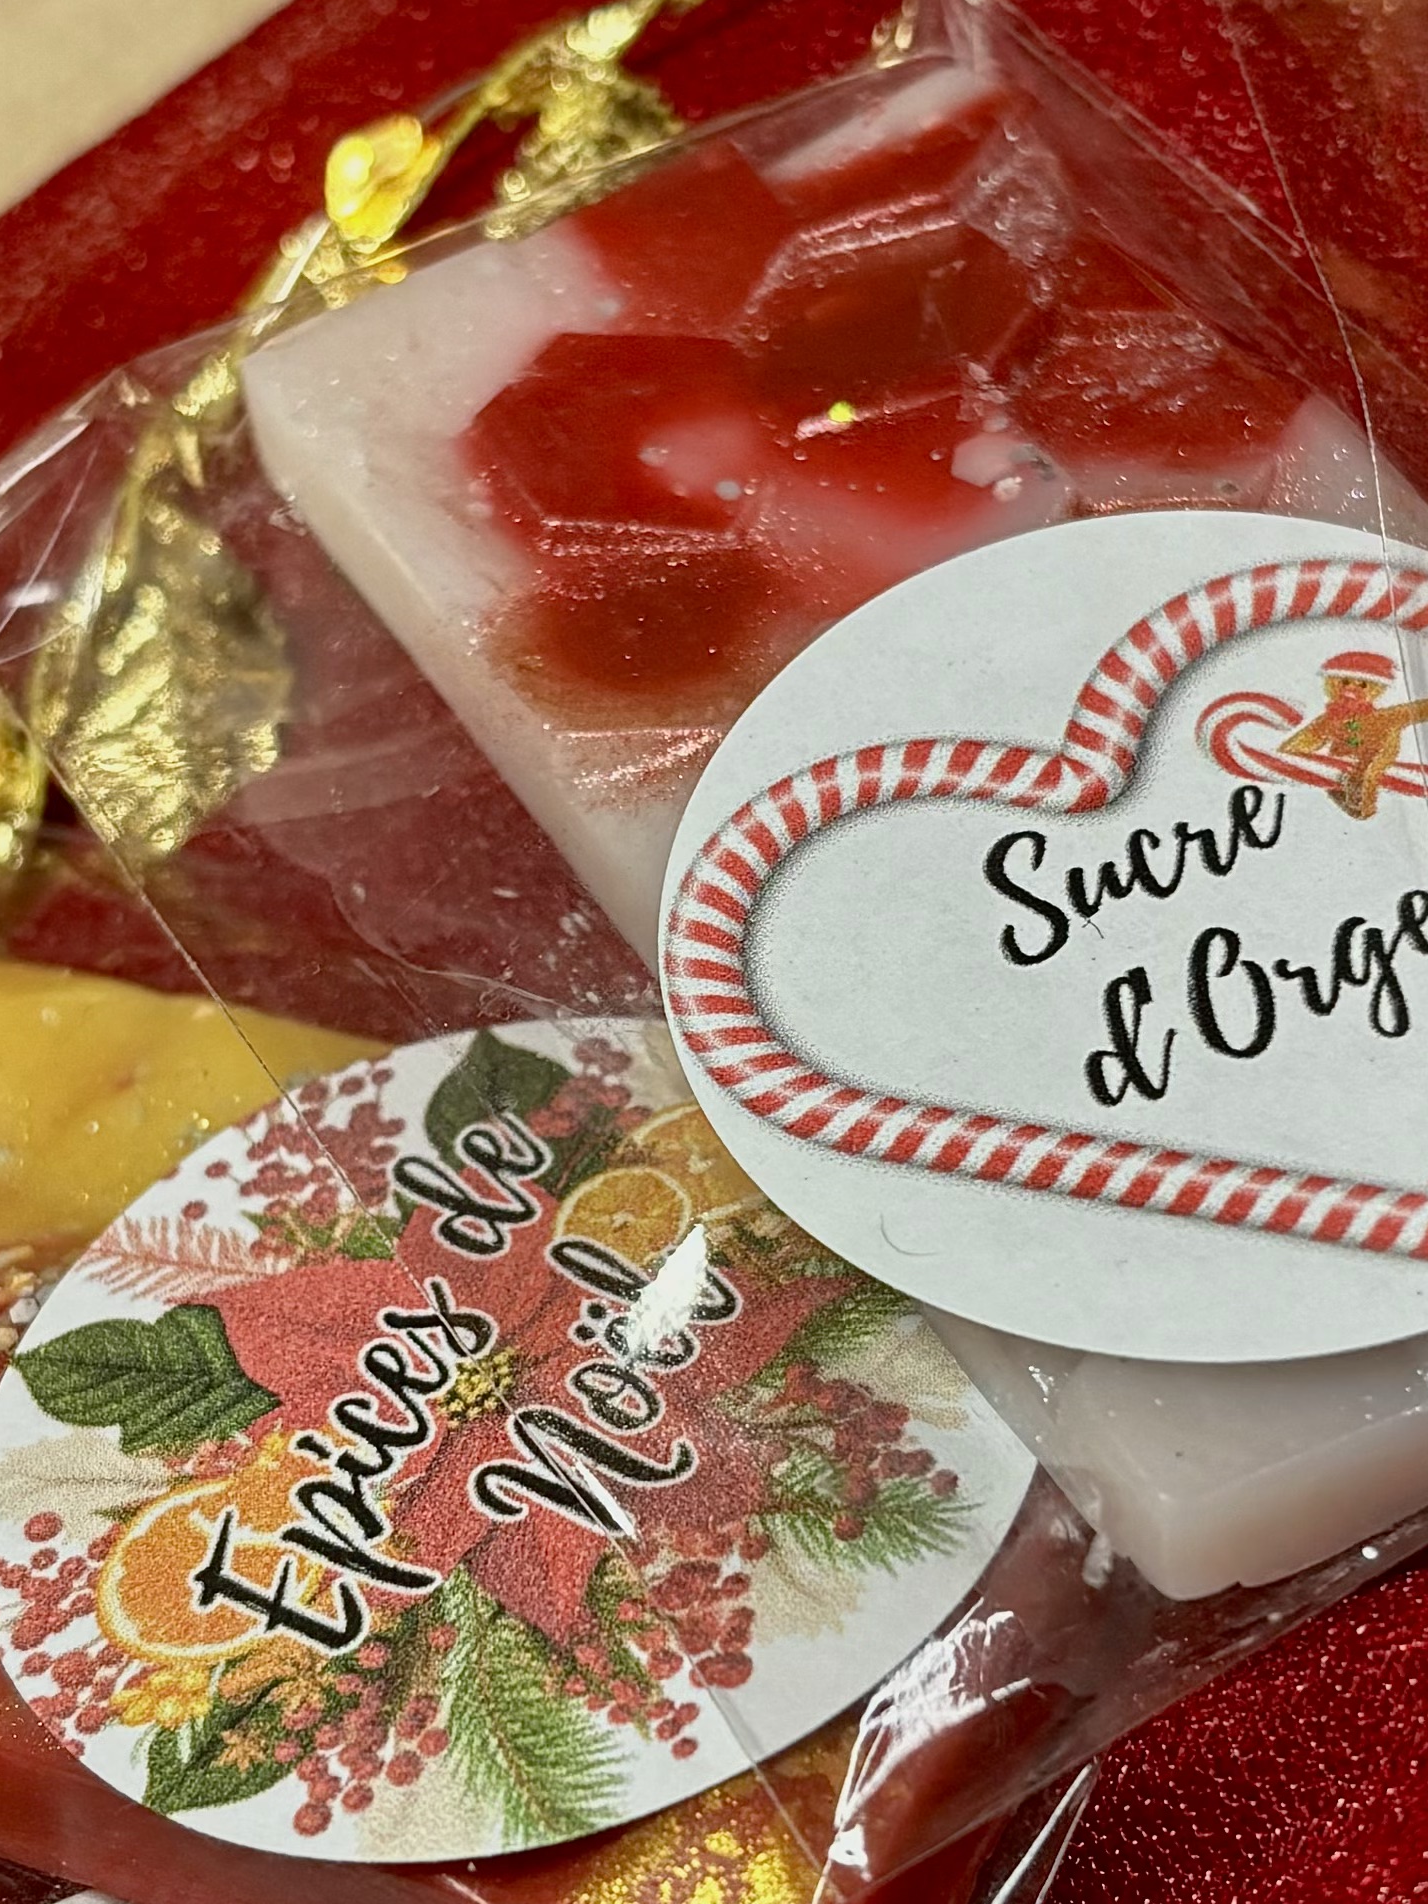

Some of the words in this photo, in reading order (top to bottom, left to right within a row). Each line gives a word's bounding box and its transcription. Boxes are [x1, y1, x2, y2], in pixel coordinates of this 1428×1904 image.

[983, 782, 1285, 965] Sucre
[189, 1280, 495, 1652] Epices
[391, 1104, 548, 1257] de
